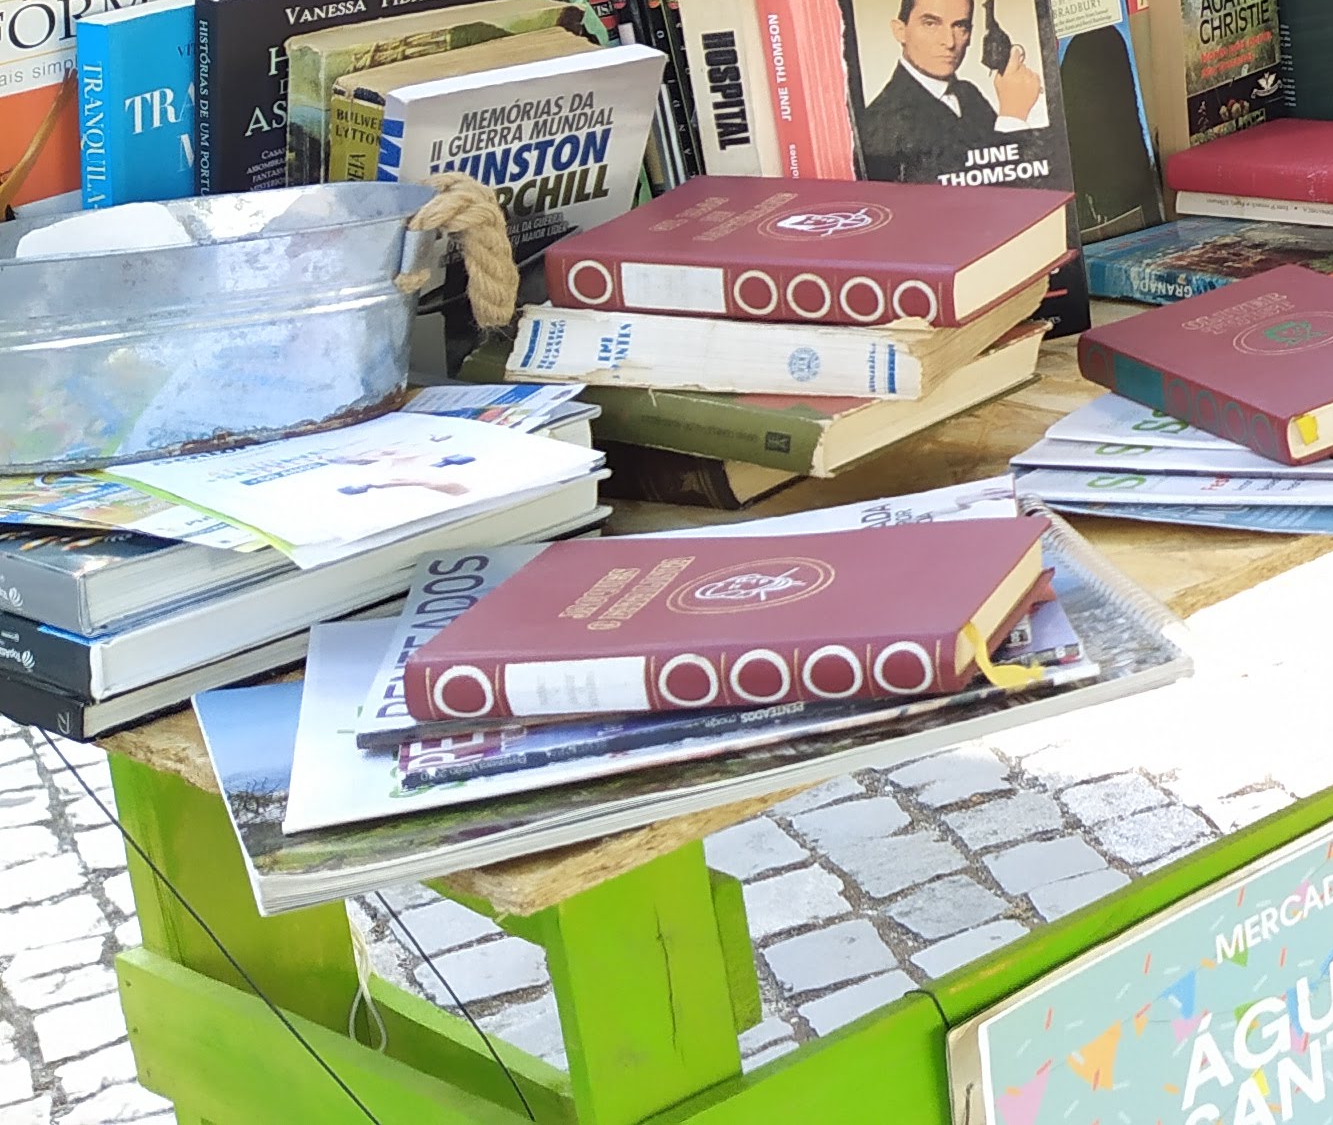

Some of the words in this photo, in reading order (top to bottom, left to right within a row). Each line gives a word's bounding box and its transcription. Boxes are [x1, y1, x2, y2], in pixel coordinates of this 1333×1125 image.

[285, 0, 367, 25] VANESSA
[199, 19, 212, 94] HISTÓRIAS
[767, 13, 787, 85] THOMSON
[0, 69, 24, 88] ais
[702, 30, 751, 152] HOSPITAL
[200, 97, 210, 119] DE
[459, 96, 563, 135] MEMÓRIAS
[569, 91, 594, 111] DA
[782, 85, 792, 122] JUNE
[200, 122, 211, 149] UM
[430, 141, 442, 163] II
[448, 123, 523, 157] GUERRA
[528, 106, 614, 140] MUNDIAL
[430, 128, 612, 186] WINSTON
[964, 144, 1020, 168] JUNE
[937, 160, 1050, 187] THOMSON
[1132, 277, 1193, 299] GRANADA
[740, 701, 806, 724] PENTEADOS
